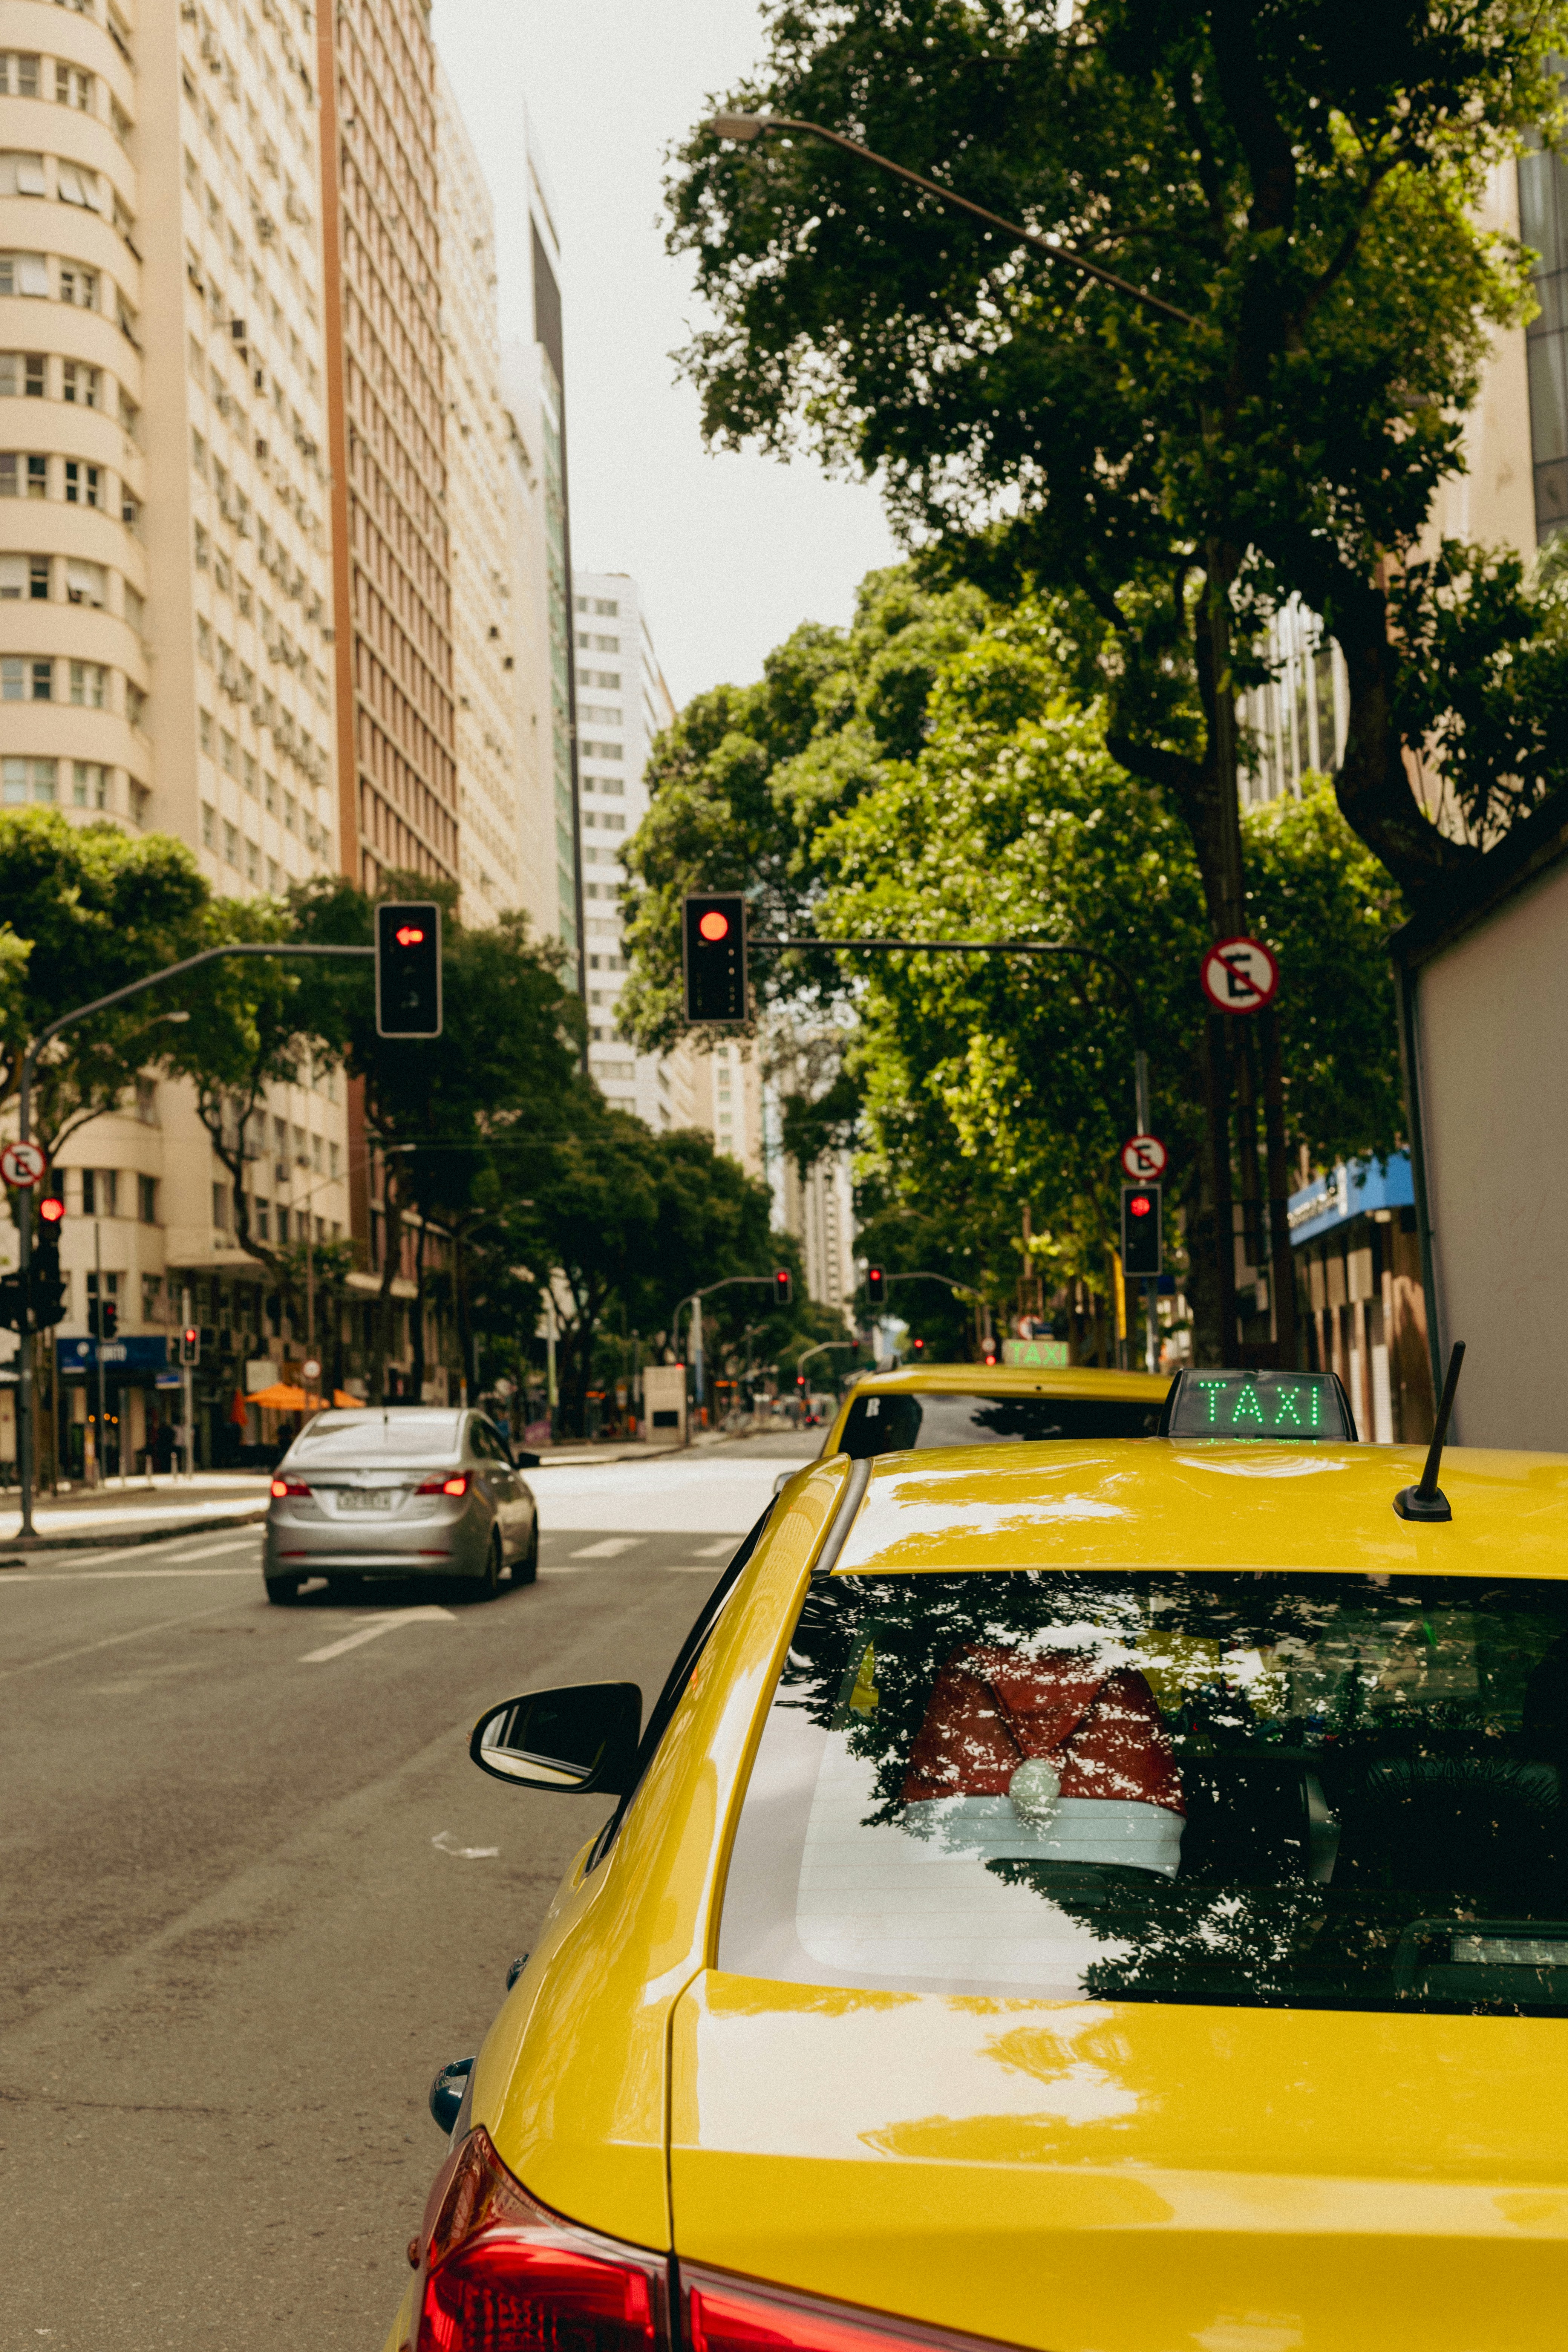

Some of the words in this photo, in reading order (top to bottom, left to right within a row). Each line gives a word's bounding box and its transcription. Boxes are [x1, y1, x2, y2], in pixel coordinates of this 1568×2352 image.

[1227, 954, 1255, 997] E
[1137, 1145, 1152, 1170] E
[1009, 1342, 1067, 1365] TAXI
[1199, 1382, 1318, 1425] TAXI
